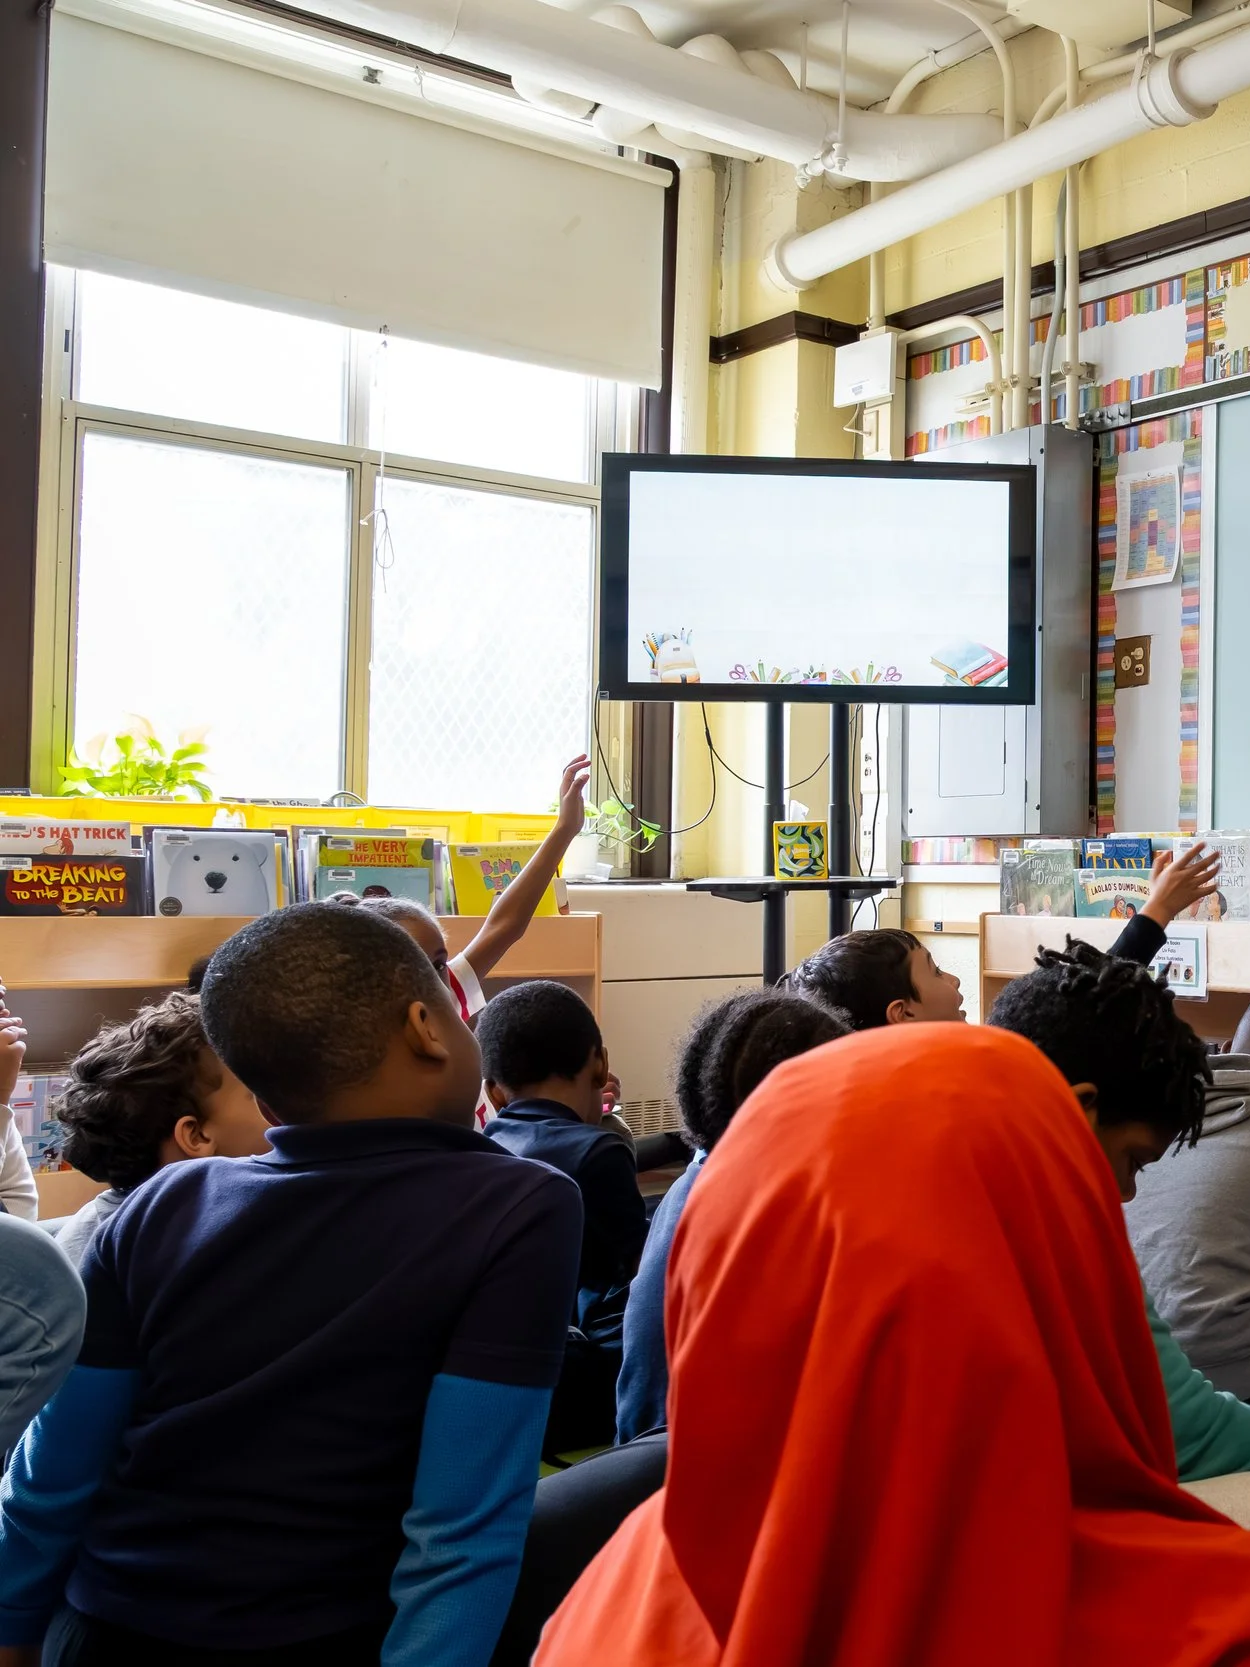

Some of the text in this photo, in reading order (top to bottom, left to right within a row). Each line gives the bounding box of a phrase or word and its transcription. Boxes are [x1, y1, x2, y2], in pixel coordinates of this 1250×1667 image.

[50, 827, 80, 838] HAT
[84, 828, 126, 840] TRICK
[355, 840, 408, 852] HE VERY
[348, 853, 408, 863] IMPATIENT
[1025, 854, 1066, 872] Time Now
[1219, 856, 1244, 868] IVEN
[13, 864, 126, 885] BREAKING
[1037, 870, 1065, 885] Dream
[62, 885, 125, 903] BEAT!
[1091, 883, 1118, 896] LAOLAO'S
